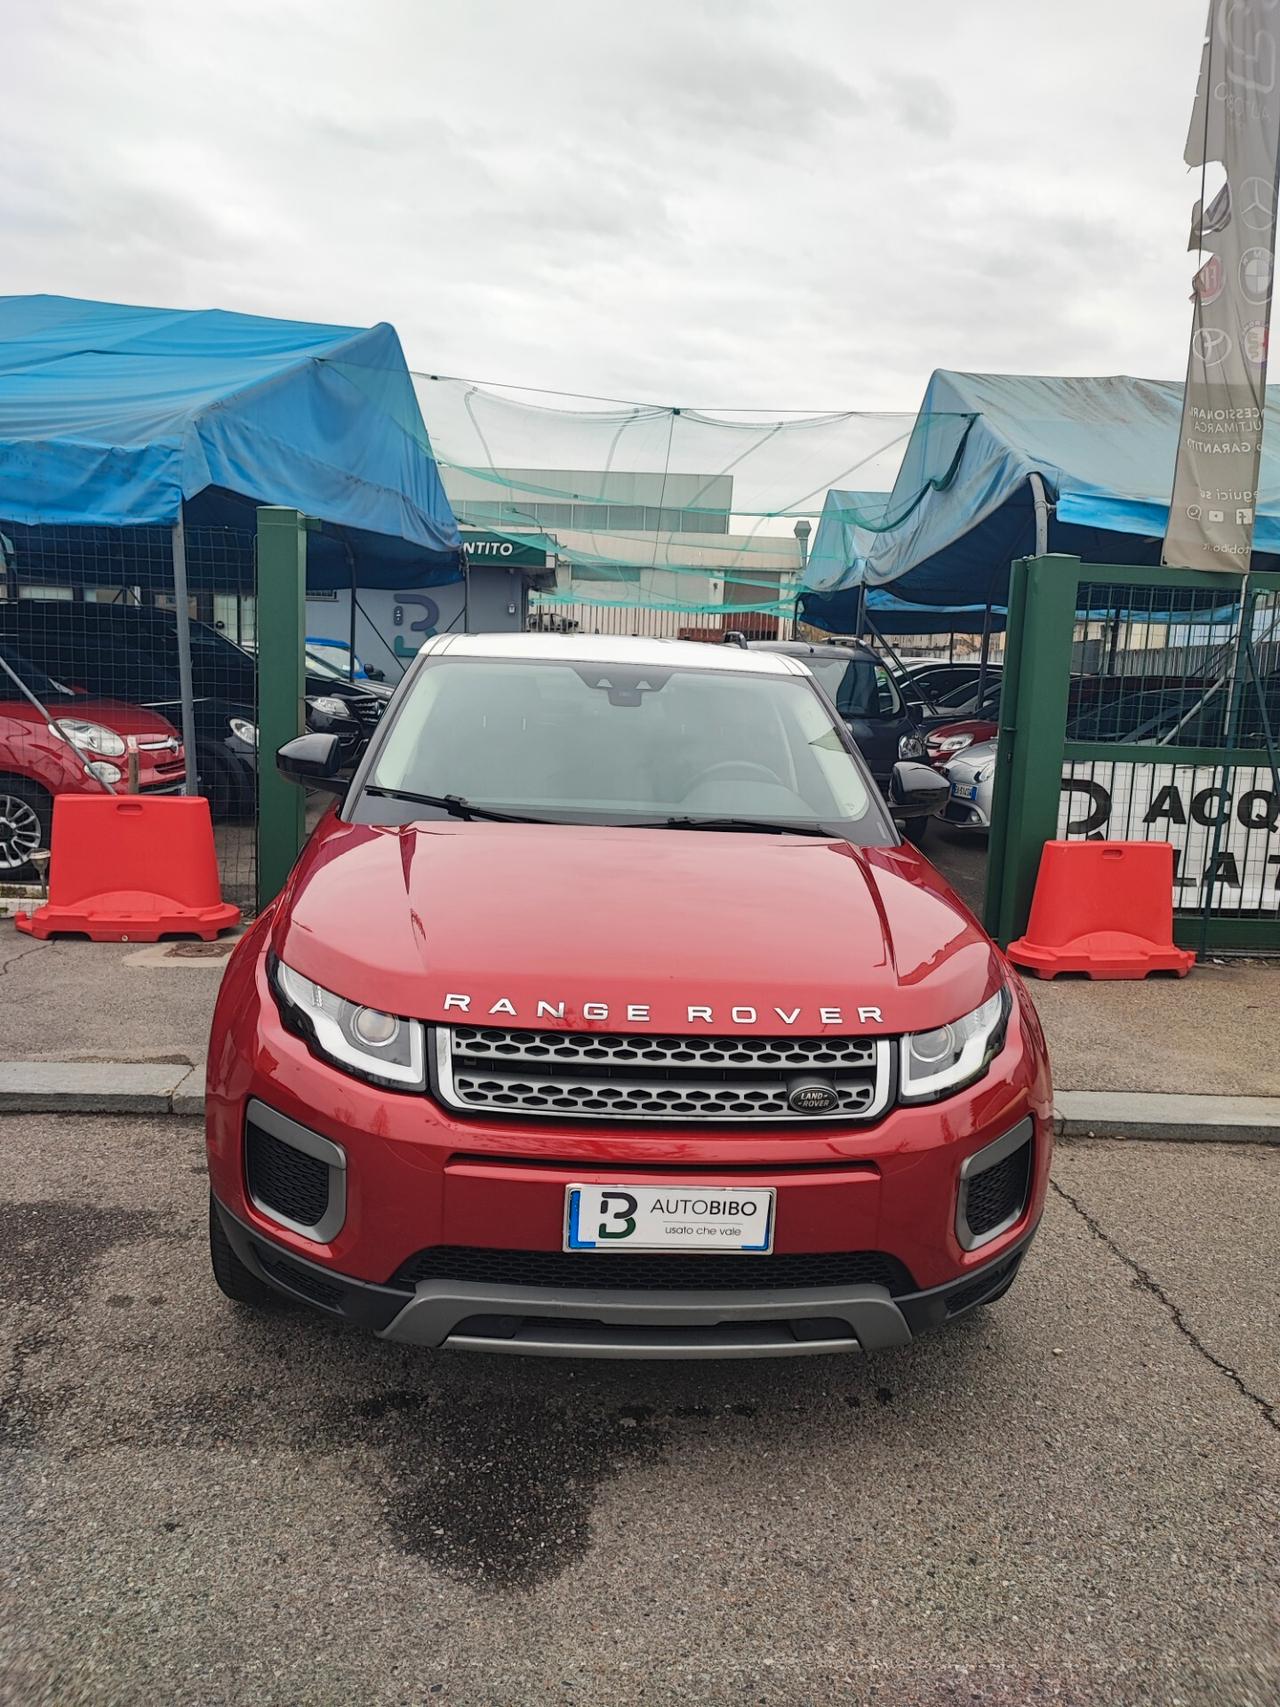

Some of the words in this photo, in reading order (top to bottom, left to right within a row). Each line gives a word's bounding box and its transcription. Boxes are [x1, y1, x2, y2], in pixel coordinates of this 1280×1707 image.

[463, 541, 513, 556] NTITO
[1142, 785, 1280, 833] ACQ
[443, 993, 652, 1022] RANGE
[687, 1006, 884, 1024] ROVER
[650, 1199, 757, 1216] AUTOBIBO
[665, 1226, 693, 1235] usato
[696, 1226, 717, 1236] che
[719, 1227, 742, 1236] vale
